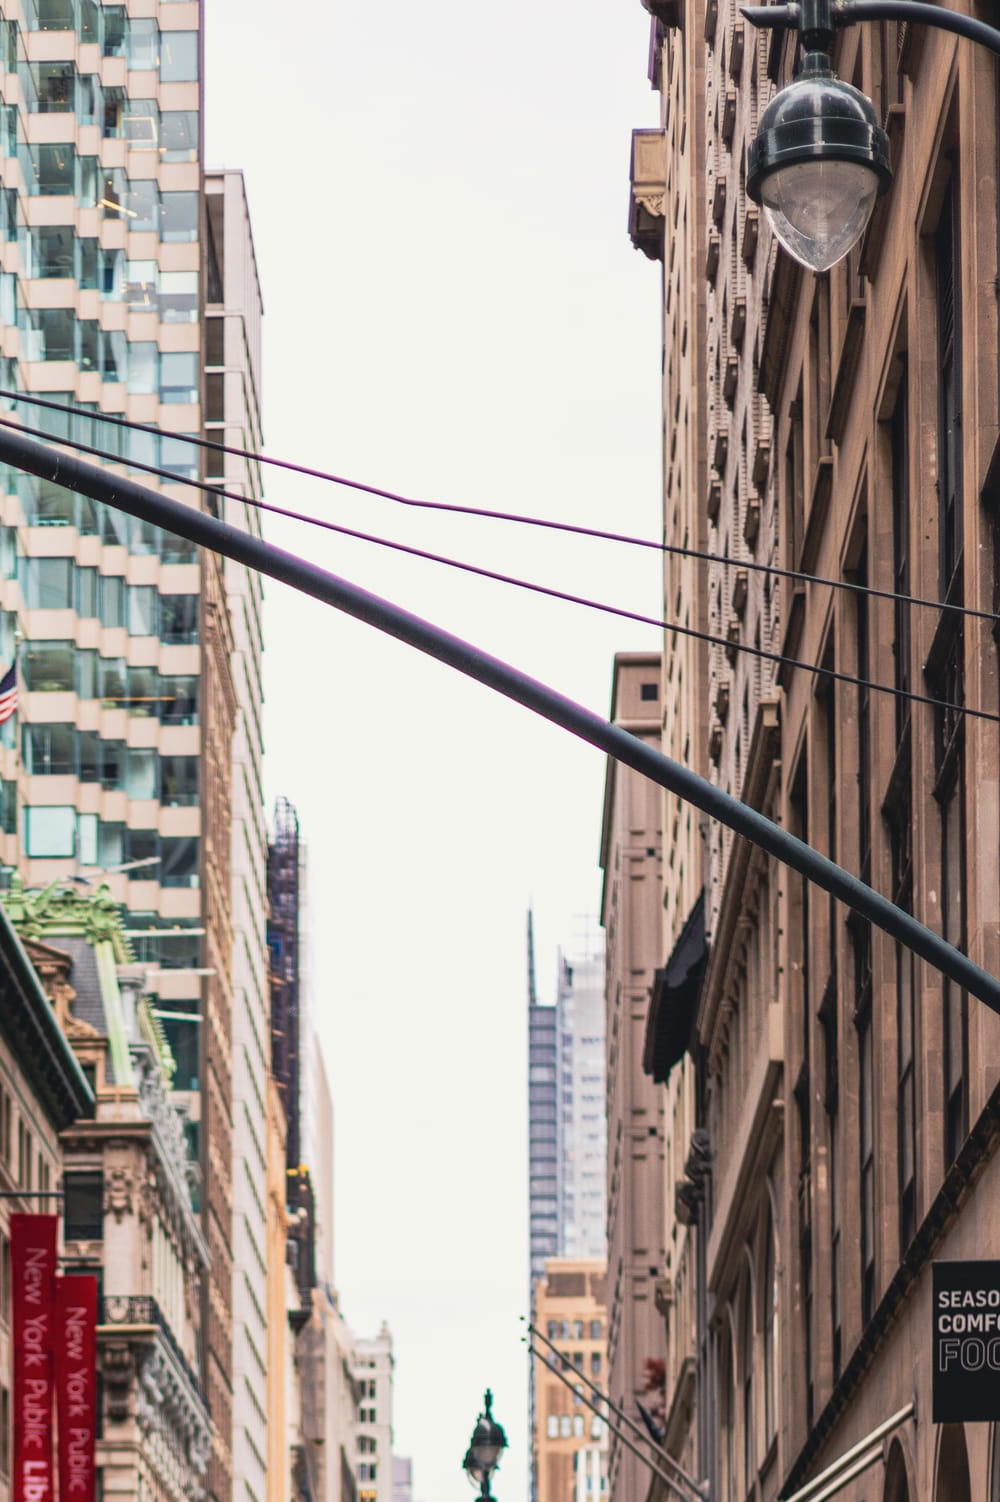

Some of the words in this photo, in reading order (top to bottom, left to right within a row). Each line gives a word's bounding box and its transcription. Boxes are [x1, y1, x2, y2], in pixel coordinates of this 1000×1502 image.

[24, 1248, 48, 1304] New
[938, 1290, 1000, 1308] SEASO
[22, 1314, 48, 1367] York
[65, 1307, 87, 1360] New
[938, 1313, 1000, 1333] COMF
[23, 1379, 48, 1448] Public
[66, 1368, 90, 1417] York
[68, 1428, 90, 1492] Public
